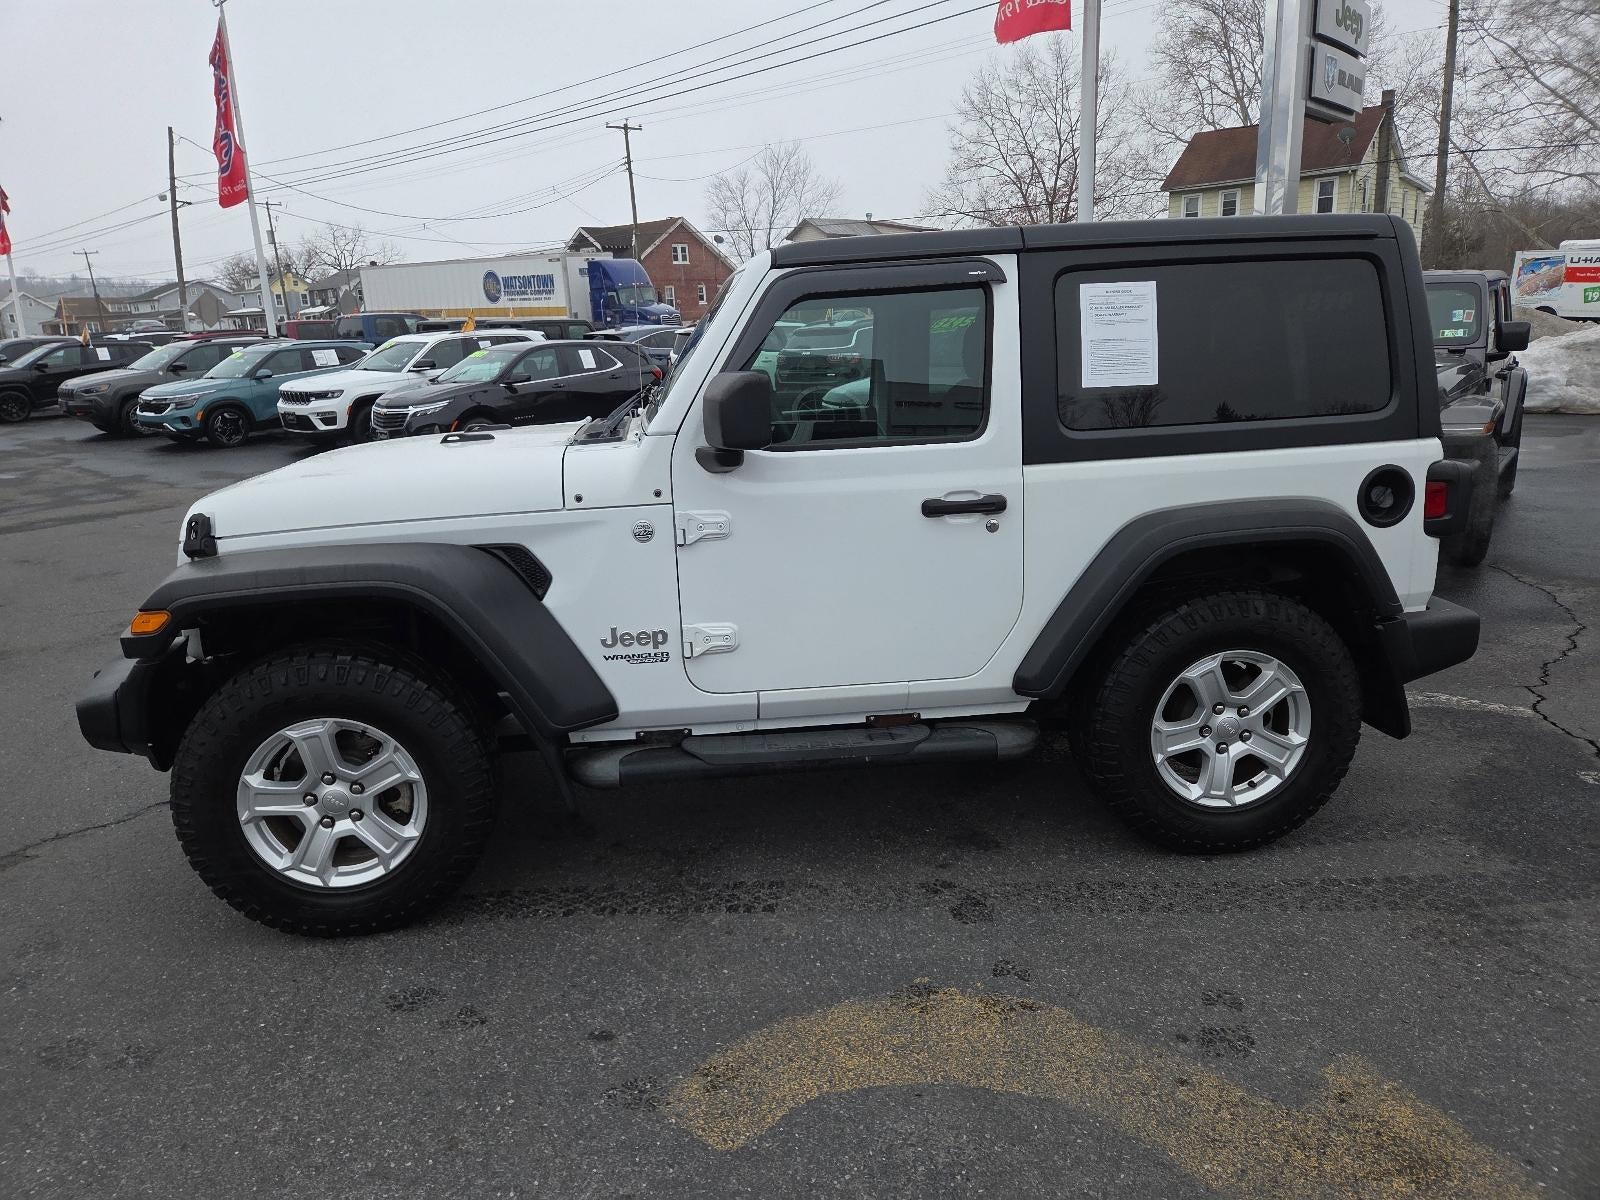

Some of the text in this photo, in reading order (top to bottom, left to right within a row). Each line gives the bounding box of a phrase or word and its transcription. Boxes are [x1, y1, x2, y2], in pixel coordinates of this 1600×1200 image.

[1336, 0, 1363, 44] Jeep
[1338, 69, 1363, 95] RAM
[502, 274, 554, 290] WATSONTOWN
[503, 288, 555, 297] TRUCKING COMPANY
[600, 626, 668, 649] Jeep
[603, 652, 670, 661] WRANGLER
